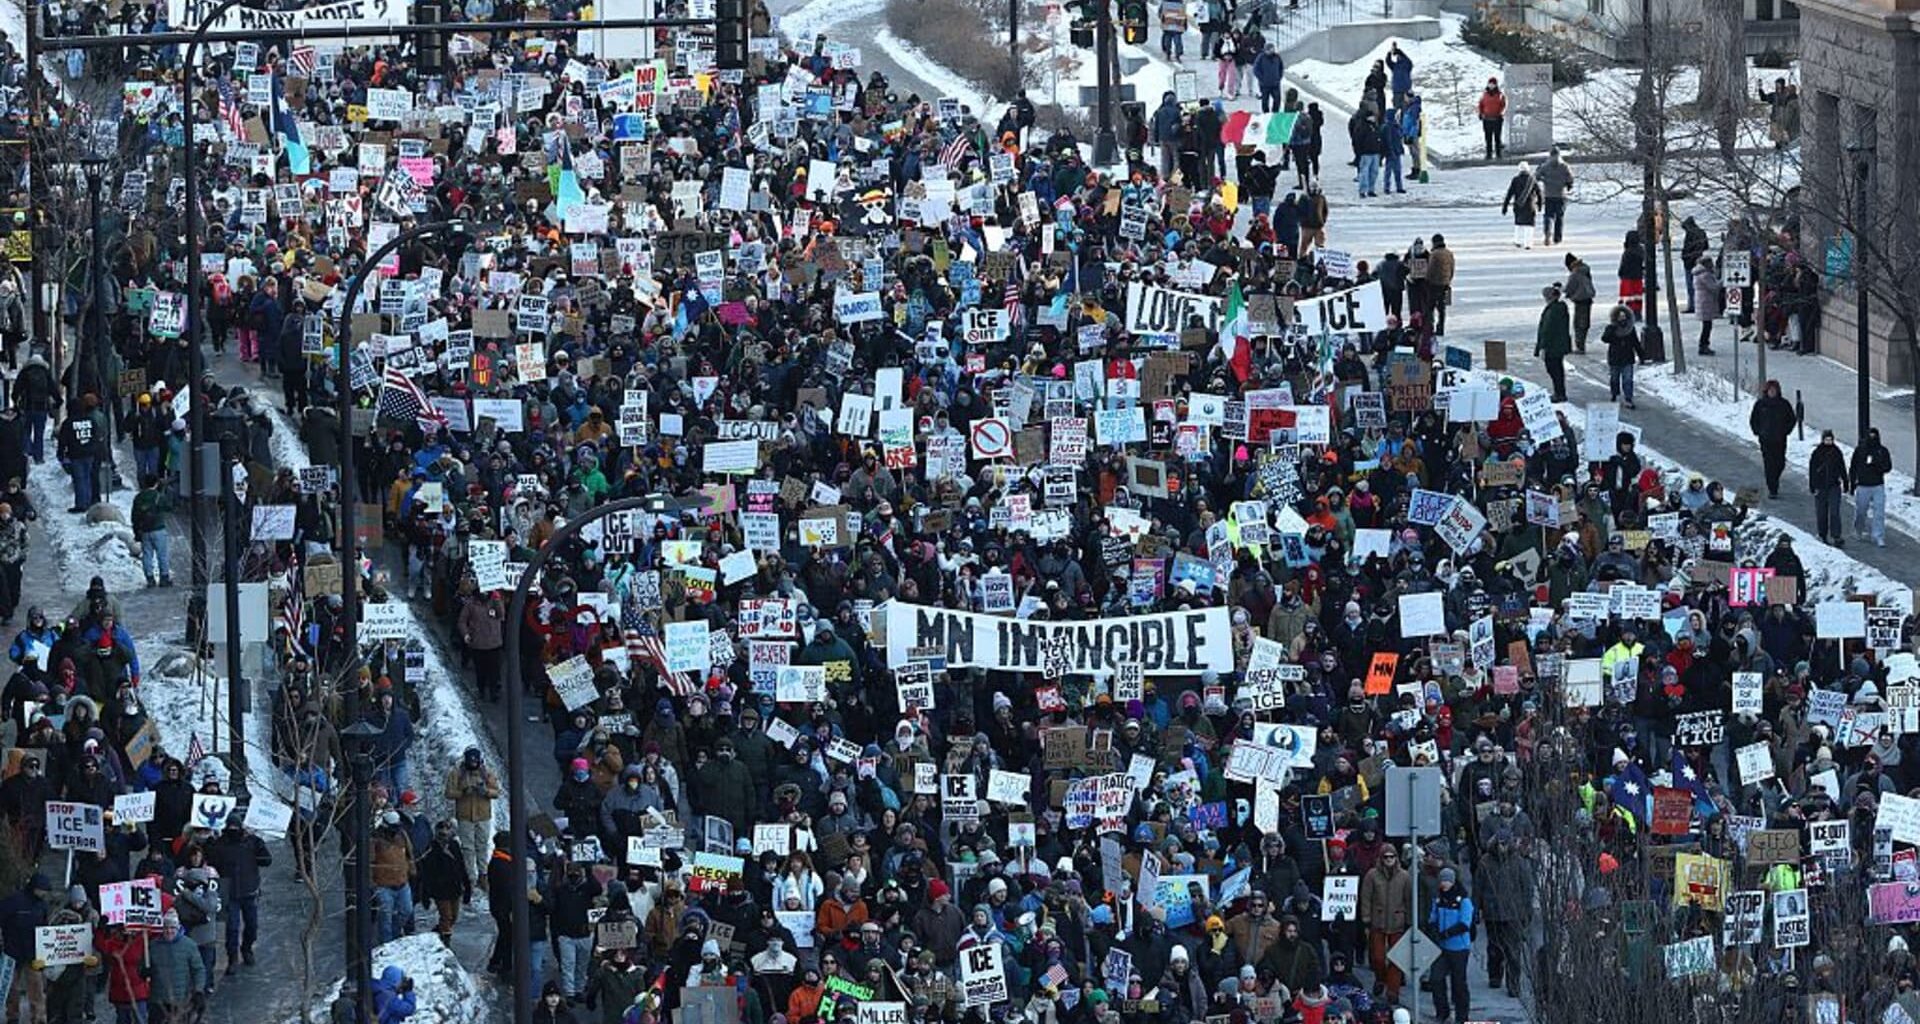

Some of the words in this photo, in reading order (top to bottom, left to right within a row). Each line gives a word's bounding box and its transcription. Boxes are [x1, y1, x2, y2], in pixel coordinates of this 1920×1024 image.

[241, 9, 298, 30] MANY
[636, 69, 657, 84] NO
[636, 93, 656, 108] NO
[1319, 289, 1365, 331] ICE
[970, 312, 998, 329] ICE
[887, 453, 914, 467] ONE
[603, 513, 632, 536] ICE
[603, 535, 633, 554] OUT
[917, 611, 974, 663] MN
[898, 673, 927, 685] ICE
[1252, 695, 1279, 709] ICE
[947, 776, 969, 797] ICE
[48, 804, 75, 815] STOP
[57, 816, 83, 832] ICE
[759, 827, 785, 841] ICE
[693, 866, 714, 878] ICE
[1333, 879, 1346, 887] BE
[131, 887, 154, 908] ICE
[1726, 894, 1762, 916] STOP
[711, 924, 732, 938] ICE
[969, 949, 995, 974] ICE
[860, 1008, 903, 1022] MILLER
